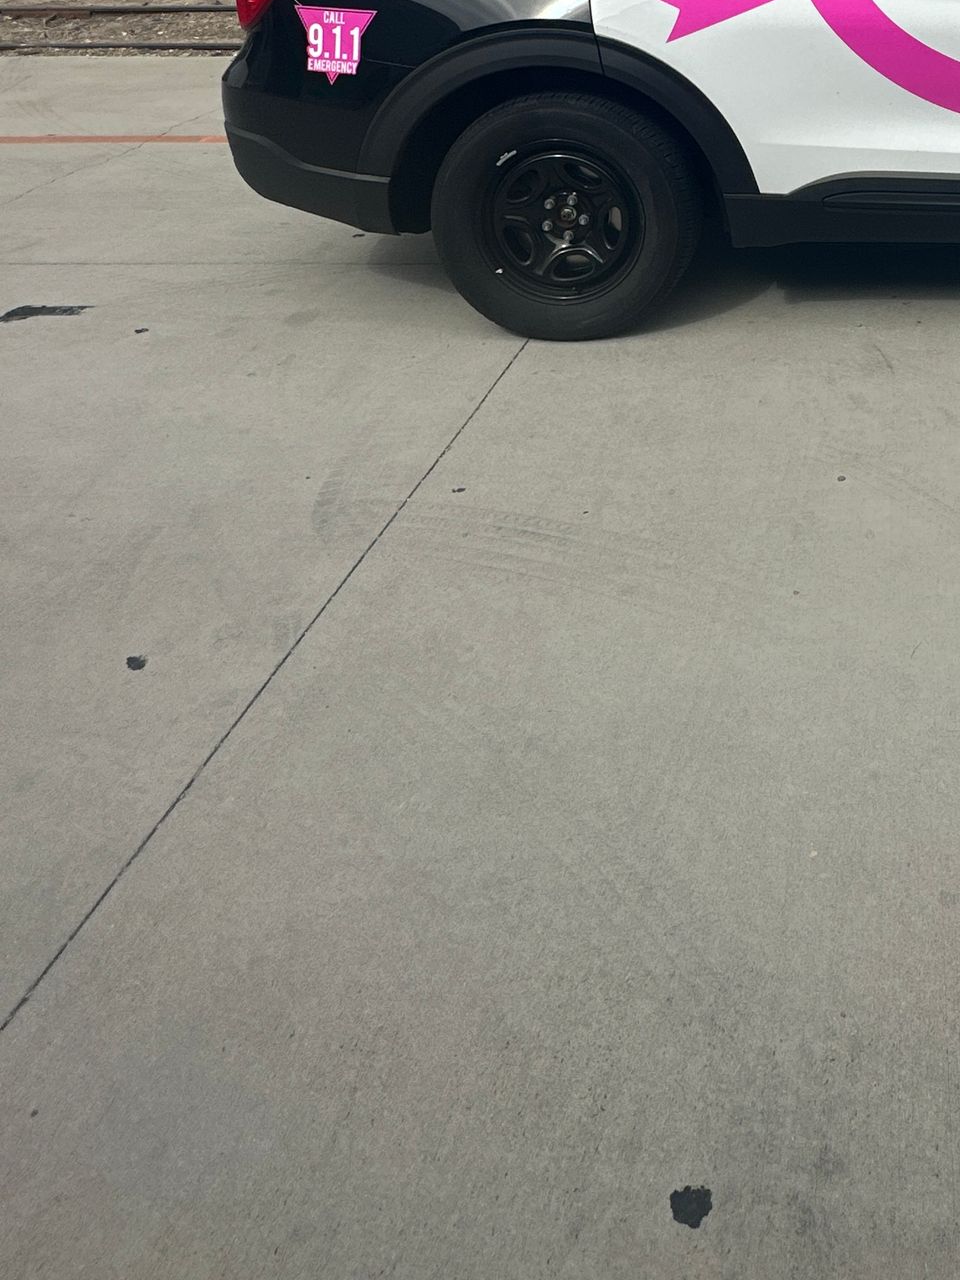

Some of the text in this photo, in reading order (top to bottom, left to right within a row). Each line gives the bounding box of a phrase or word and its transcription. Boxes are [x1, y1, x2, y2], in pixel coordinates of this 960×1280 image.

[323, 10, 345, 25] CALL
[307, 22, 360, 60] 9.1.1
[307, 58, 358, 75] EMERGENCY
